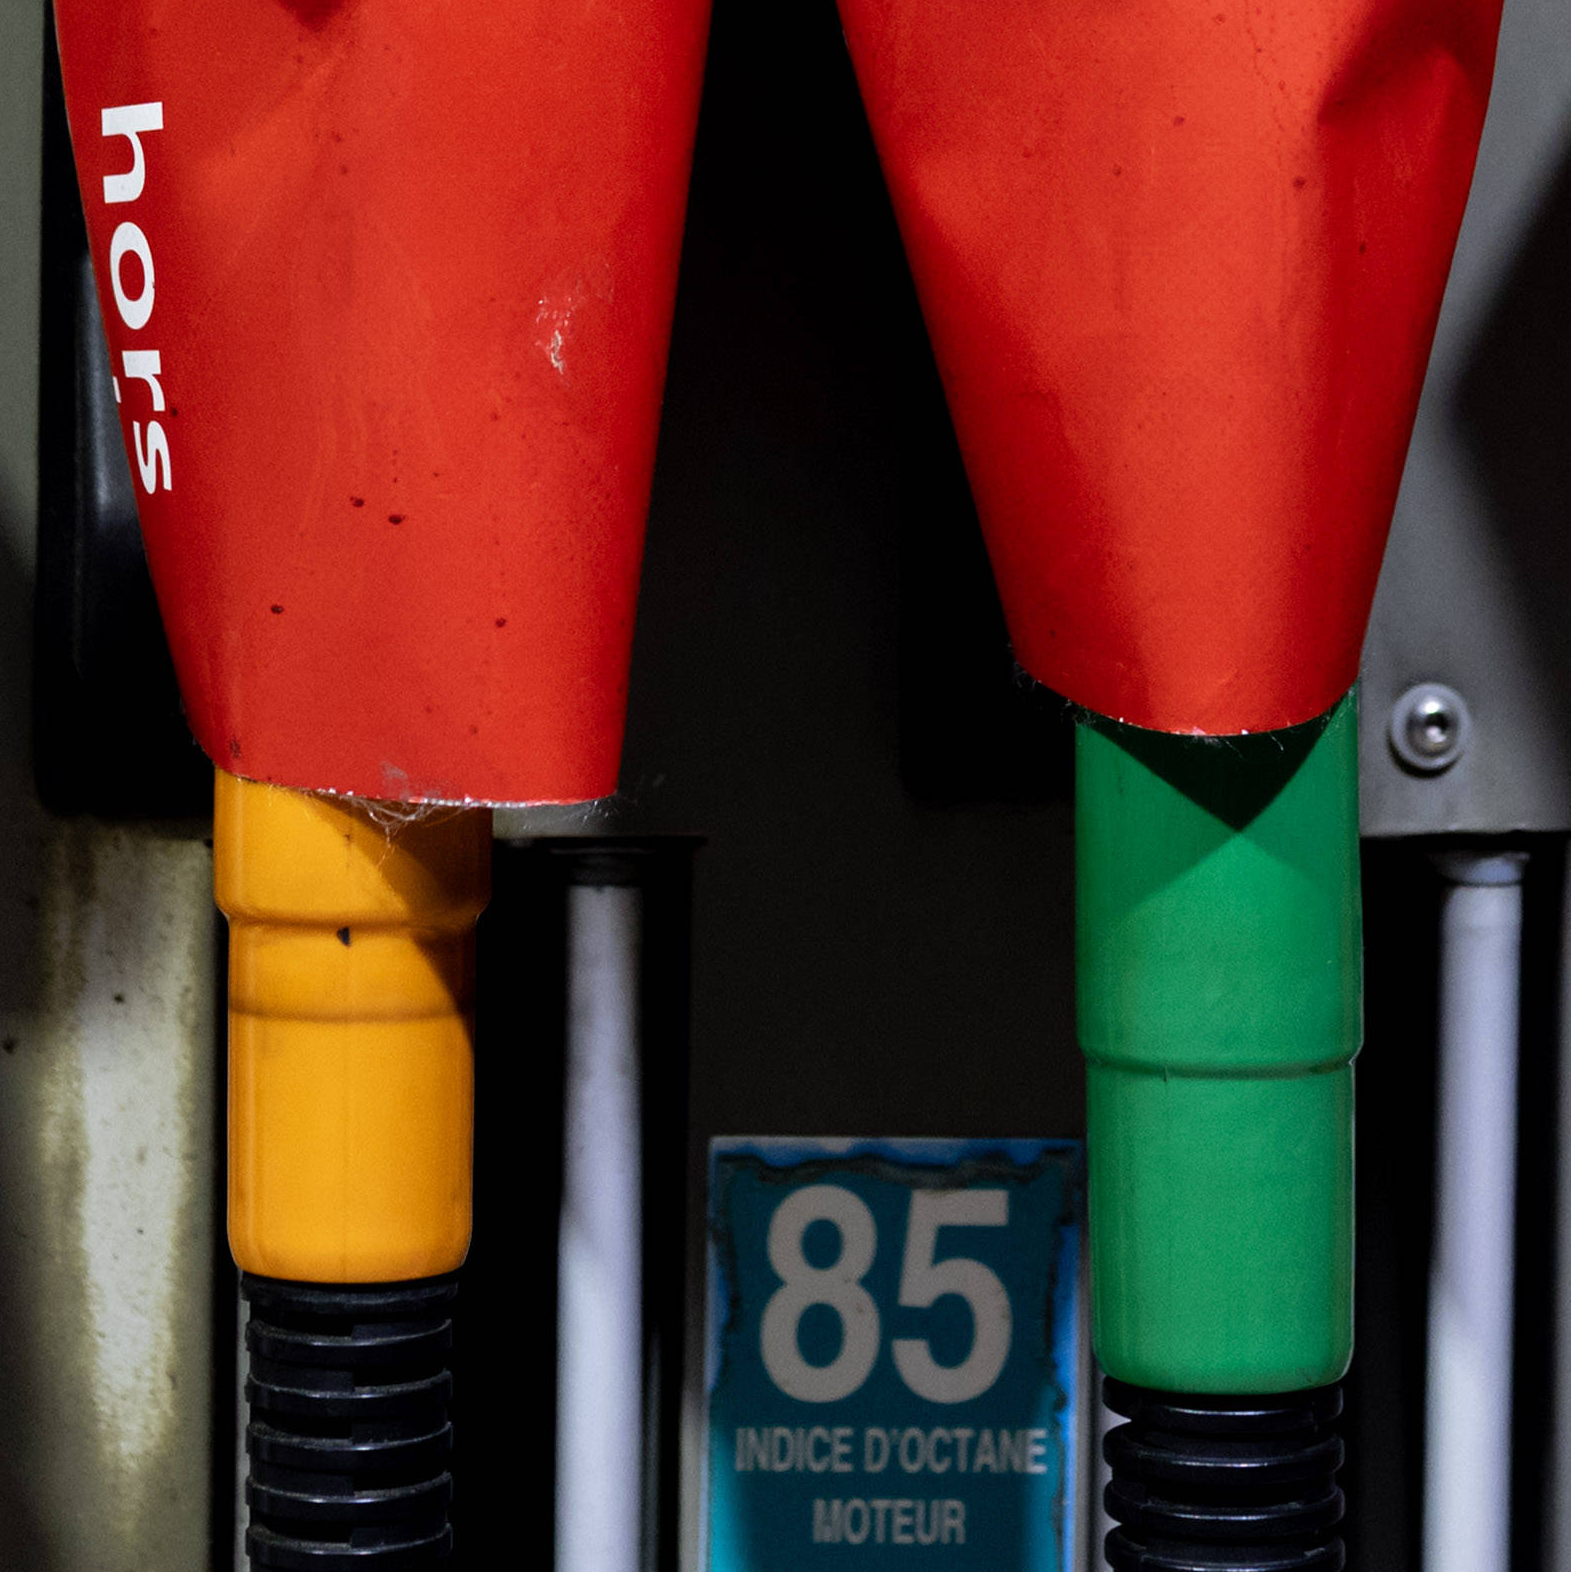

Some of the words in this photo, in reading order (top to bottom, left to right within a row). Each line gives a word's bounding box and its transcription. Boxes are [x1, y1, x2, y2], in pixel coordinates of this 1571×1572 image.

[101, 101, 173, 495] hors
[759, 1183, 1013, 1405] 85
[733, 1425, 854, 1474] INDICE
[863, 1425, 1049, 1475] D'OCTANE
[811, 1497, 967, 1546] MOTEUR
